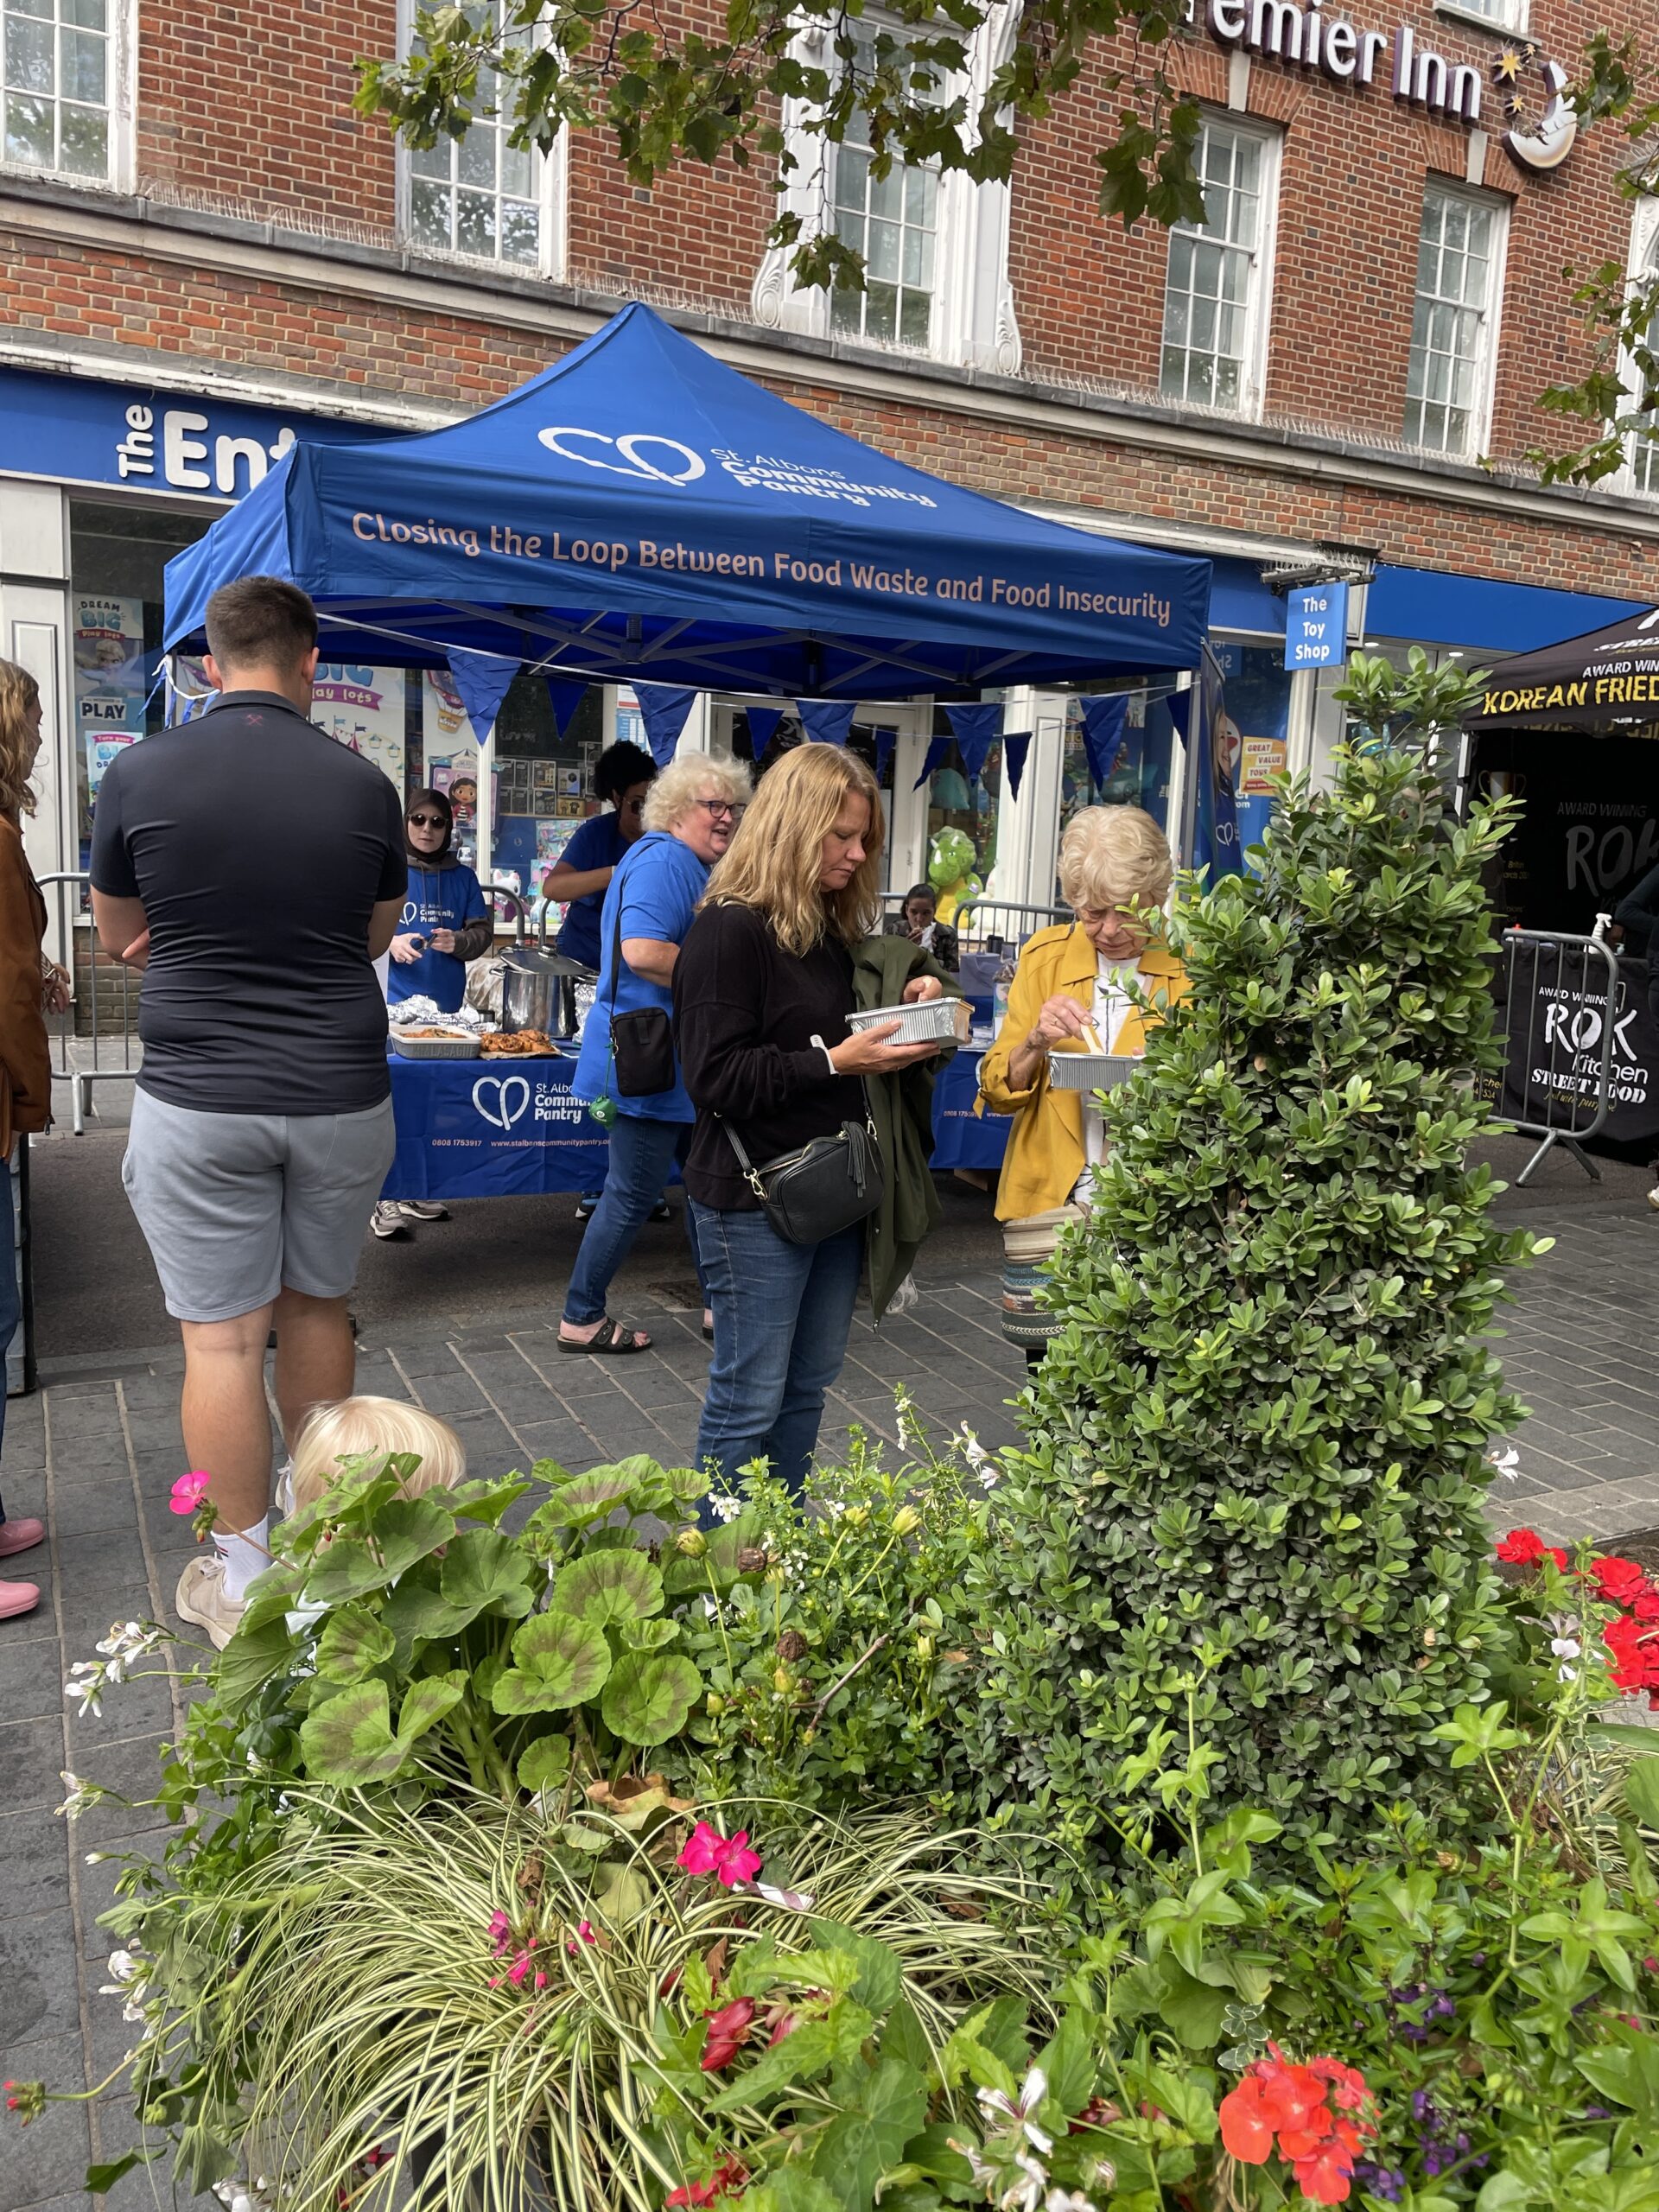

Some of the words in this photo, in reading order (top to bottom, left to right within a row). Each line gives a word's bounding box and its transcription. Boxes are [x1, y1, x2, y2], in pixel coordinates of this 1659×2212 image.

[1185, 0, 1387, 83] emier
[1393, 26, 1482, 124] Inn
[116, 404, 154, 478] The
[710, 448, 750, 464] St.
[755, 454, 846, 480] Albans
[721, 461, 938, 508] Community
[733, 474, 871, 507] Pantry
[352, 512, 479, 557] Closing
[490, 525, 542, 558] the
[553, 532, 629, 572] Loop
[639, 540, 766, 578] Between
[775, 553, 842, 587] Food
[850, 563, 929, 596] Waste
[936, 575, 982, 602] and
[991, 578, 1050, 608] Food
[1058, 585, 1170, 628] Insecurity
[80, 601, 120, 612] DREAM
[1302, 597, 1327, 613] The
[80, 609, 121, 630] BIG
[1302, 621, 1325, 640] Toy
[1295, 643, 1330, 662] Shop
[1582, 661, 1632, 678] AWARD
[1635, 659, 1659, 672] WIN
[312, 688, 334, 699] lay
[343, 688, 372, 703] lots
[1482, 681, 1588, 715] KOREAN
[81, 702, 125, 719] PLAY
[1247, 744, 1271, 753] GREAT
[1258, 755, 1281, 764] VALUE
[1249, 768, 1268, 777] TOYS
[1557, 801, 1597, 816] AWARD
[1545, 1002, 1637, 1062] ROK
[536, 1083, 549, 1094] St.
[1531, 1068, 1592, 1094] STREET
[535, 1108, 582, 1124] Pantry
[453, 1139, 482, 1147] 1753917
[490, 1139, 611, 1147] www.stalbanscommunitypantry.or
